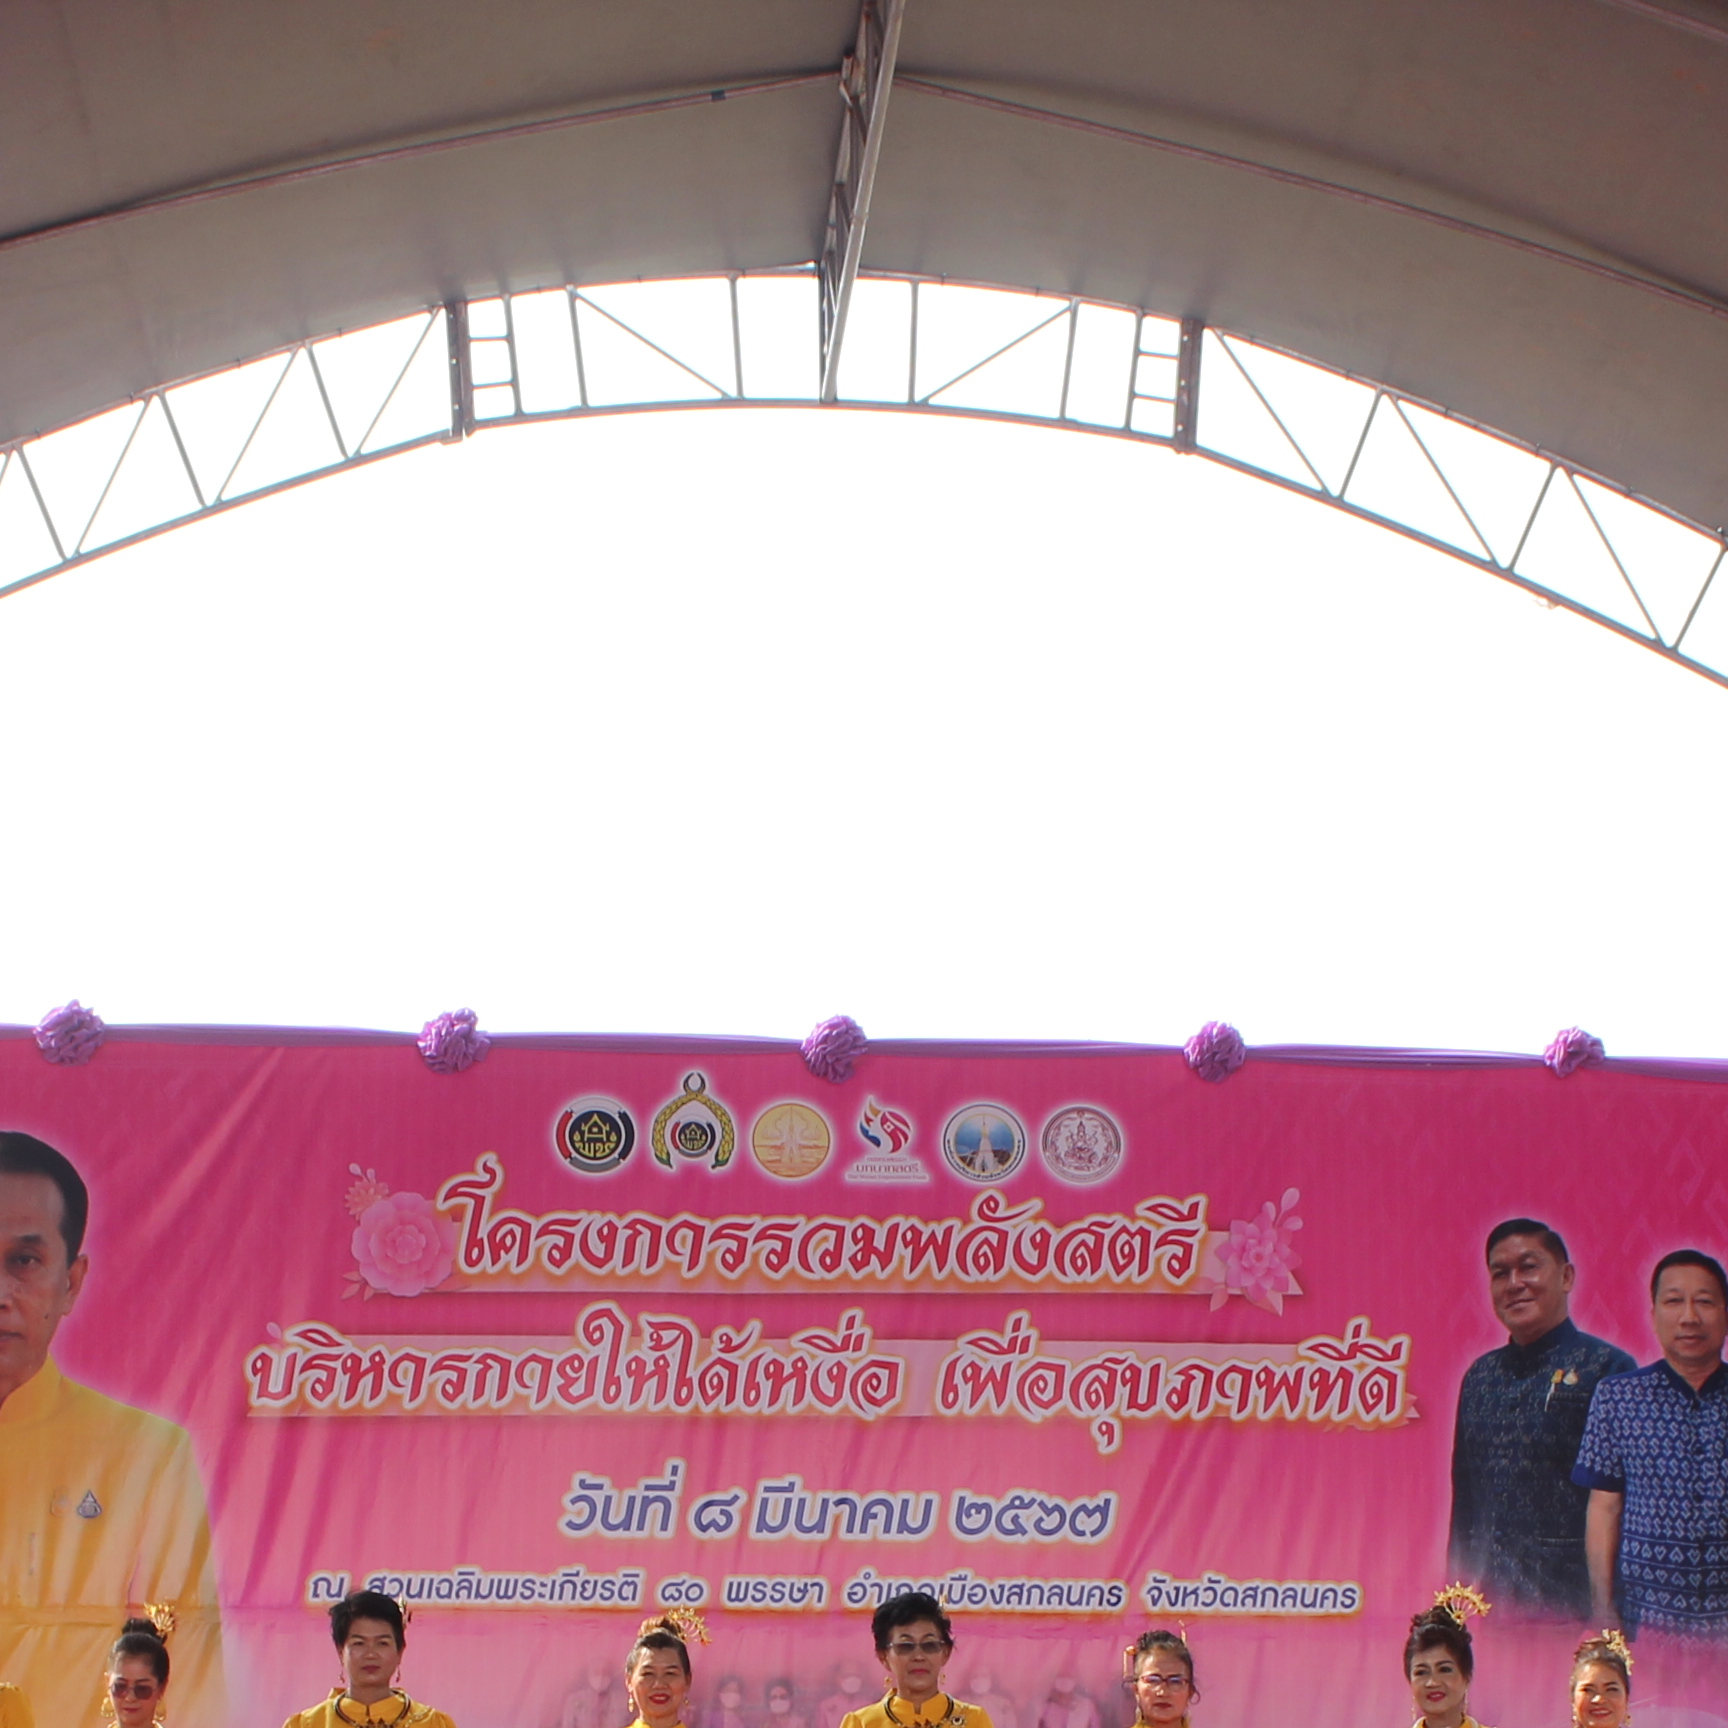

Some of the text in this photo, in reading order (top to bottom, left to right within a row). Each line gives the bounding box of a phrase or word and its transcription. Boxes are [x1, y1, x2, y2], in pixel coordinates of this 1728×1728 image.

[440, 1157, 1205, 1282] โครงการรวมพลังสตรี
[248, 1305, 904, 1416] บริหารกายให้ได้เหงื่อ
[564, 1463, 1114, 1539] วันที่ ๘ มีนาคม ๒๕๖๗
[311, 1575, 345, 1600] ณ
[367, 1570, 642, 1602] สวนเฉลิมพระเกียรติ
[659, 1582, 706, 1604] ๘๐
[726, 1578, 827, 1604] พรรษา
[1146, 1576, 1359, 1610] จังหวัดสกลนคร
